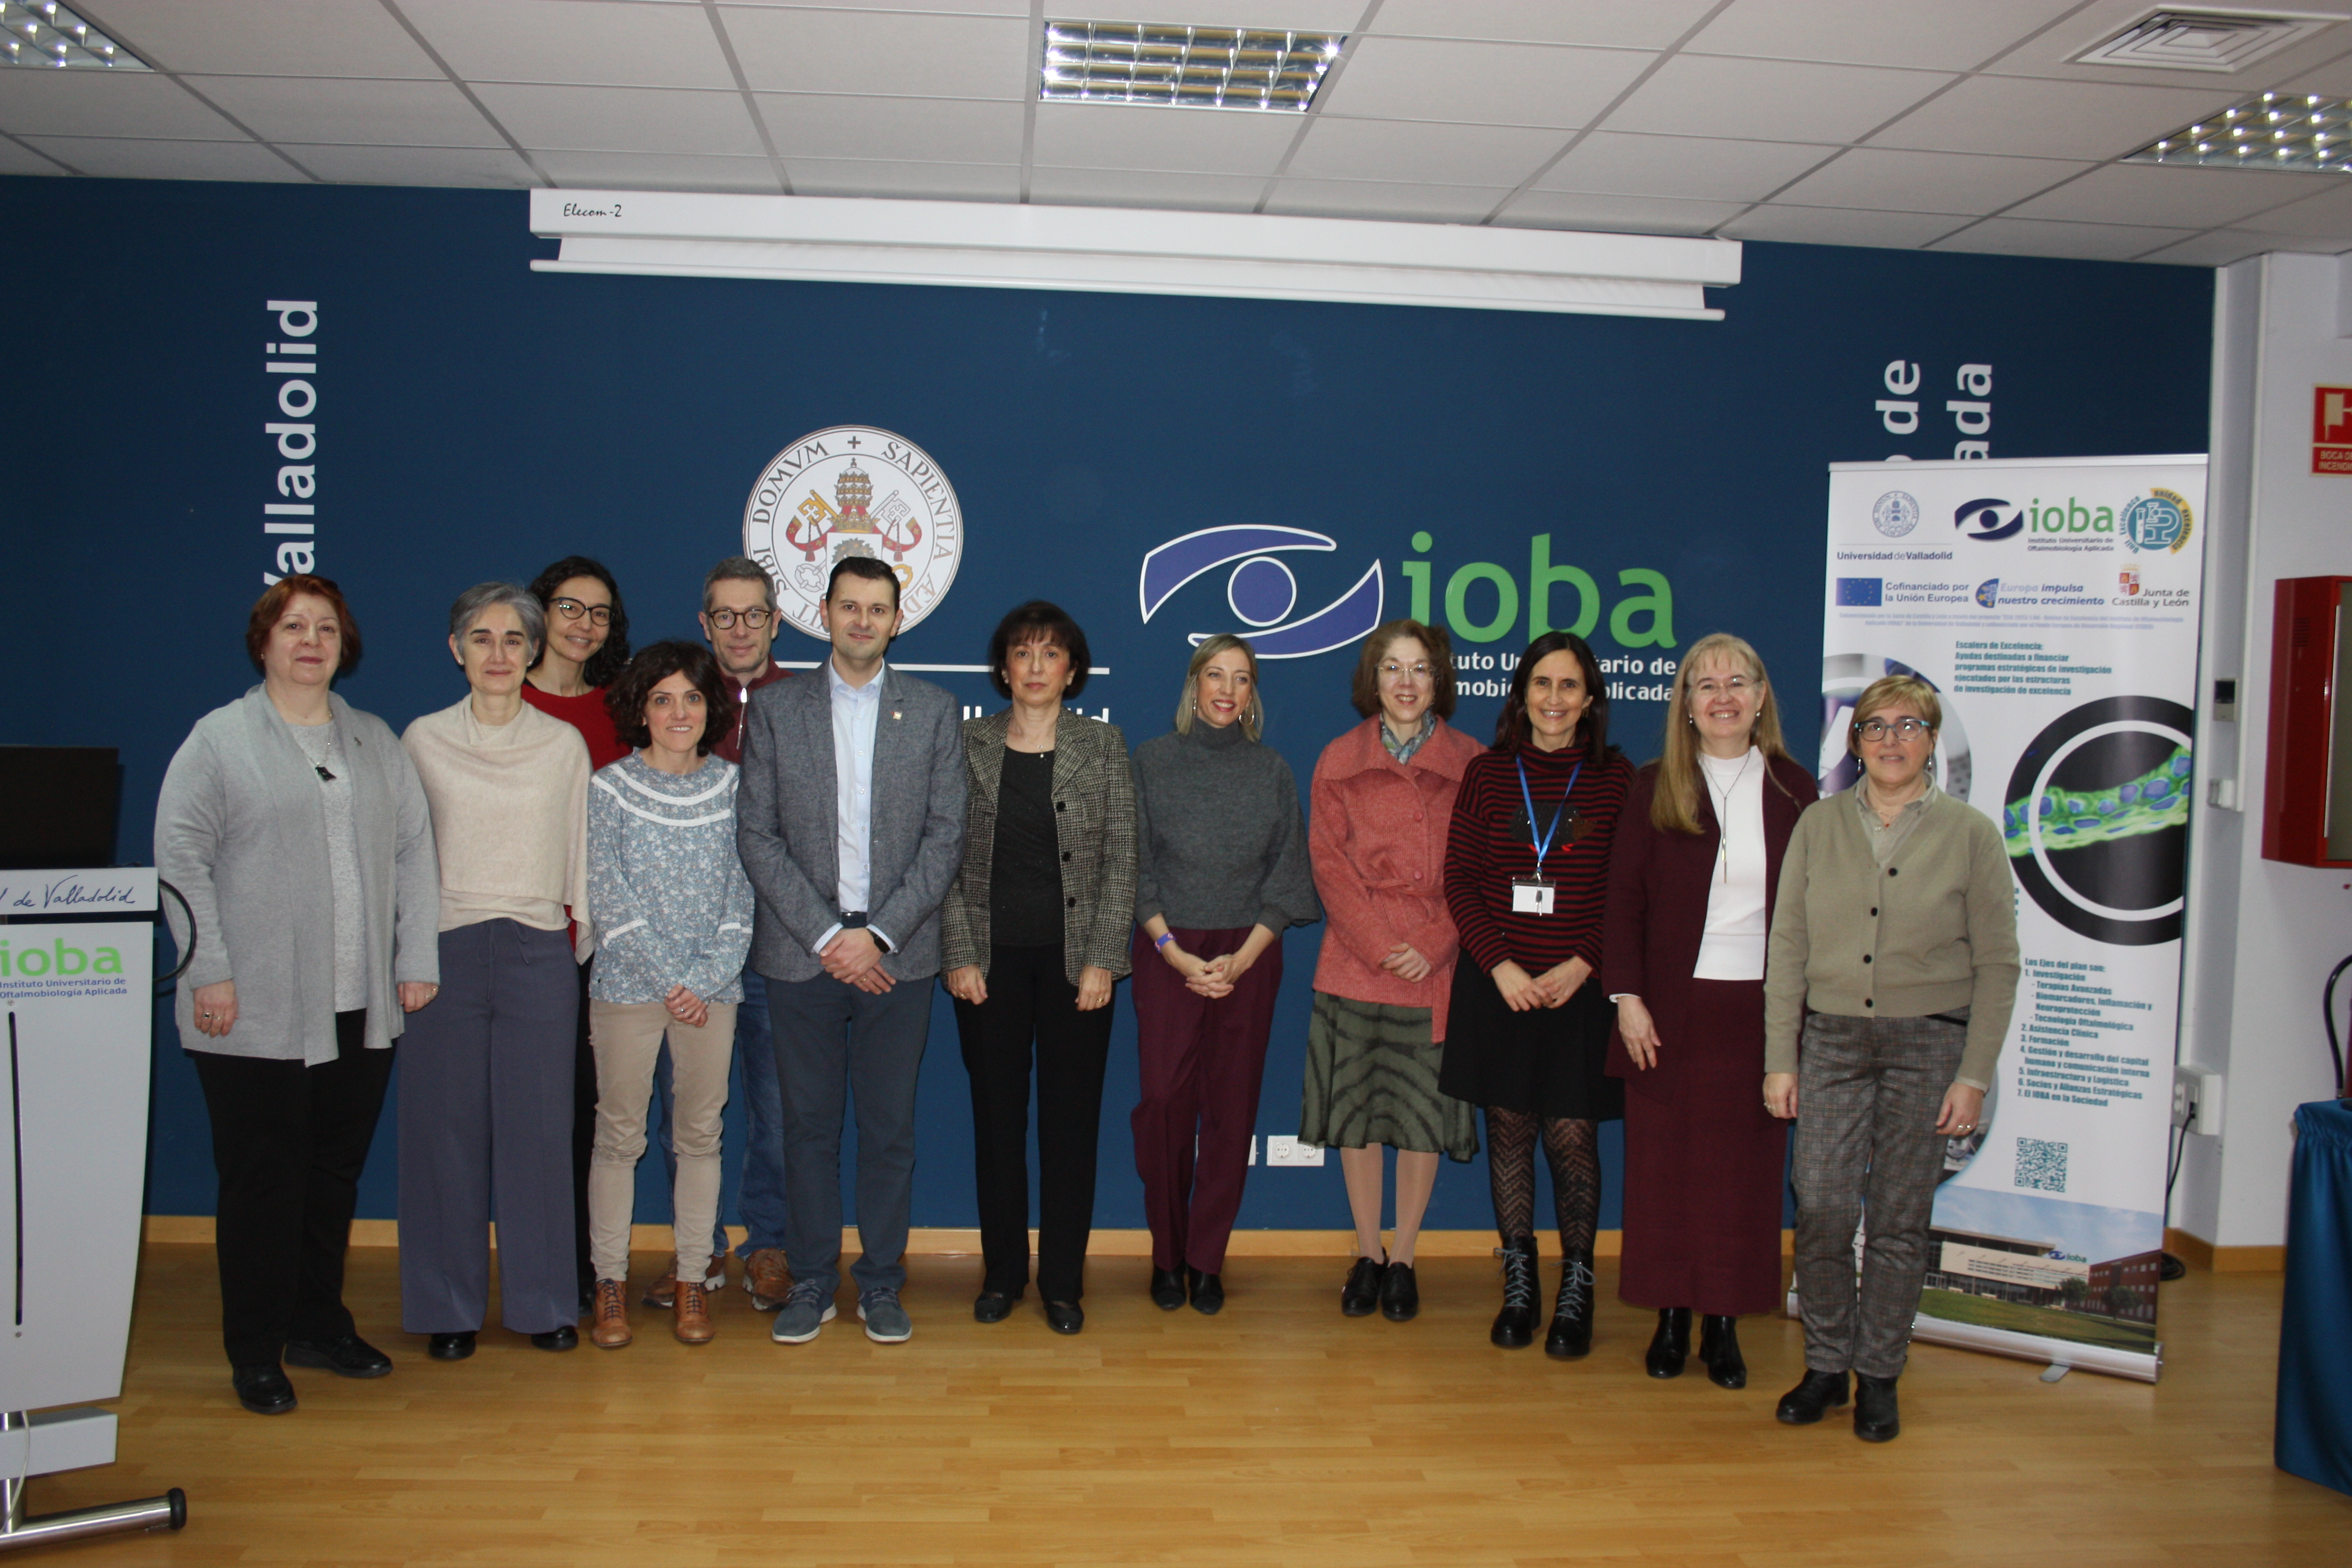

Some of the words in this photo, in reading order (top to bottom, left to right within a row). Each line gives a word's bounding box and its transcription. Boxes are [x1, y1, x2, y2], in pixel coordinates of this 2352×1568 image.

[563, 203, 622, 217] Elecom-2
[1875, 360, 1920, 434] de
[1946, 363, 1992, 460] ada
[263, 300, 318, 586] alladolid
[2320, 451, 2343, 460] BOCA
[753, 440, 830, 525] DOMVM
[881, 441, 955, 560] SAPIENTIA
[2029, 497, 2115, 532] ioba
[1402, 531, 1678, 649] ioba
[1885, 582, 1949, 591] Cofinanciado
[1952, 584, 1969, 592] por
[2041, 583, 2084, 594] impulsa
[1928, 594, 1969, 603] Europea
[2142, 589, 2172, 597] Junta
[2176, 589, 2190, 597] de
[1997, 596, 2037, 605] nuestro
[2040, 597, 2104, 606] crecimiento
[2112, 597, 2149, 606] Castilla
[2153, 599, 2159, 608] y
[2163, 597, 2190, 607] León
[1956, 641, 1988, 649] Escalera
[1989, 641, 1999, 650] de
[1955, 652, 1982, 660] Ayudas
[1984, 652, 2026, 661] destinadas
[1649, 657, 1676, 676] de
[1605, 682, 1673, 701] licada
[2028, 687, 2071, 695] excelencia
[13, 890, 36, 907] de
[43, 875, 136, 908] Valladolid
[0, 937, 124, 977] ioba
[2056, 960, 2068, 969] del
[2070, 961, 2087, 971] plan
[2033, 970, 2086, 981] Investigación
[46, 979, 111, 987] Universitario
[2037, 981, 2069, 992] Terapias
[2071, 984, 2112, 995] Avanzadas
[0, 988, 82, 999] Oftalmobiología
[85, 988, 127, 997] Aplicada
[2029, 1024, 2069, 1036] Asistencia
[2029, 1035, 2070, 1047] Formación
[2106, 1054, 2119, 1063] del
[2026, 1079, 2052, 1089] Socios
